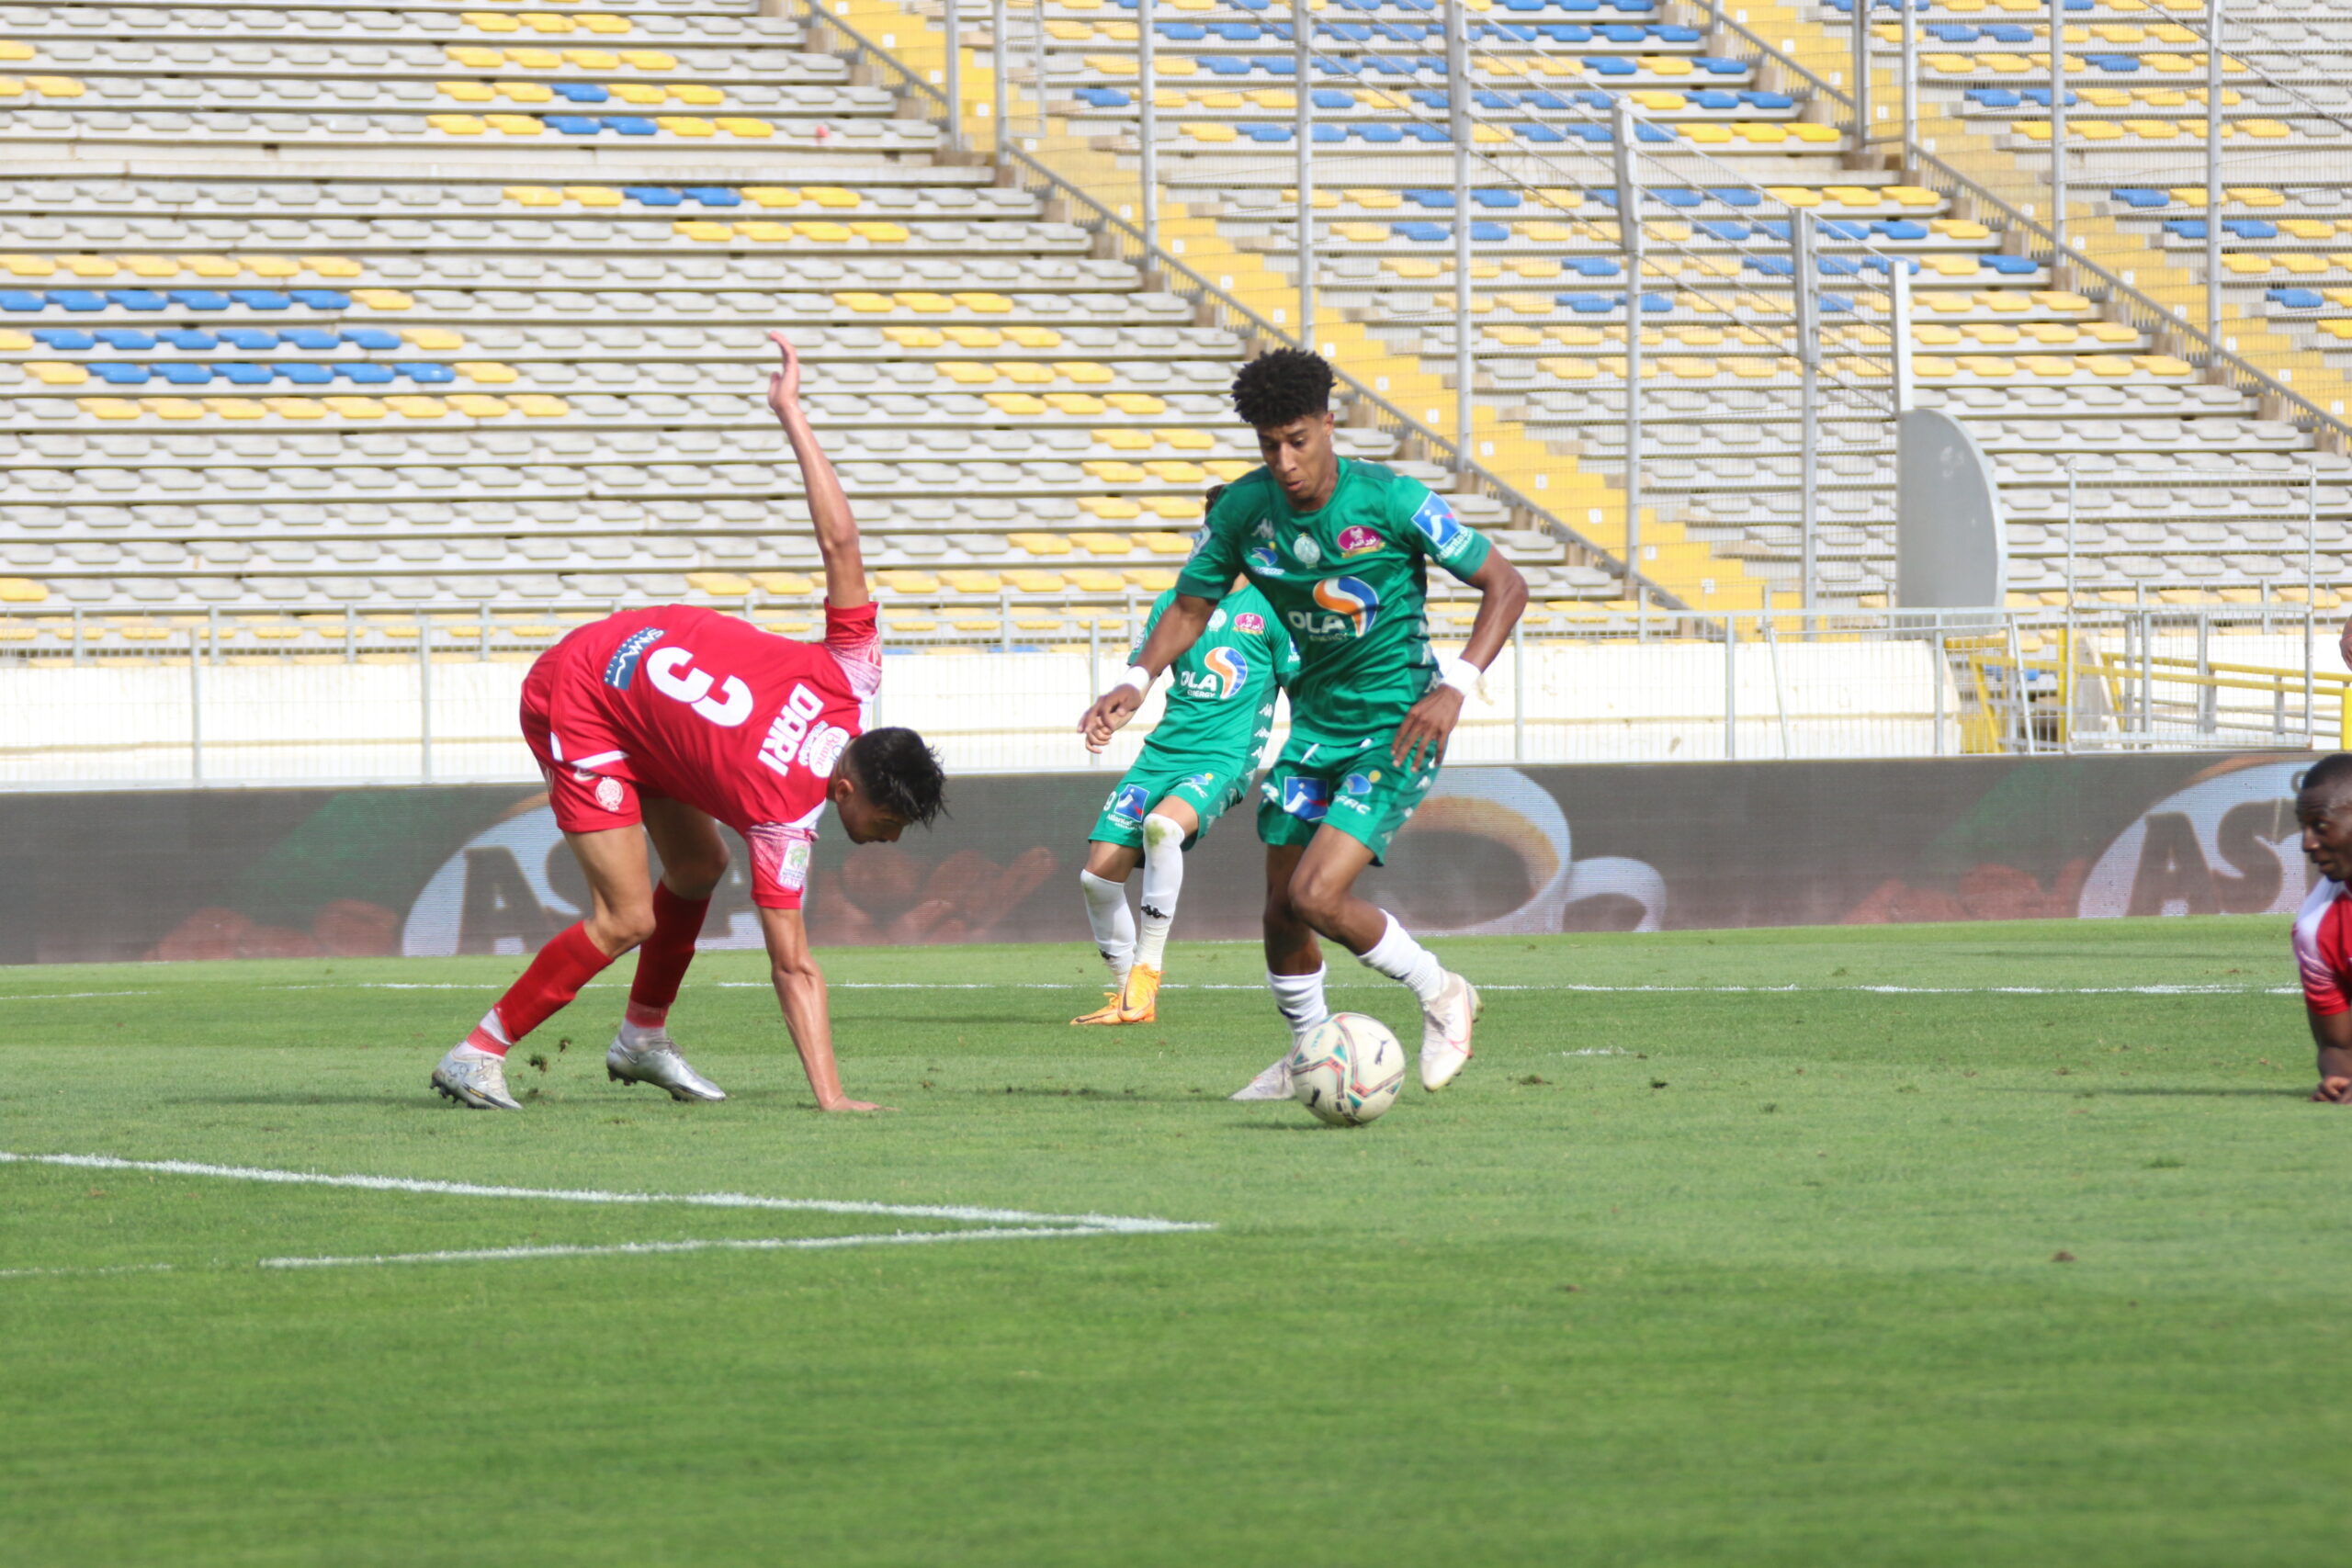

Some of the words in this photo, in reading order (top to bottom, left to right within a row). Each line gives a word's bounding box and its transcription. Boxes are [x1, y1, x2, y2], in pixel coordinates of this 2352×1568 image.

[1288, 610, 1346, 634] OLA
[646, 647, 753, 727] 3
[1181, 671, 1217, 692] OLA
[757, 682, 824, 777] DARI
